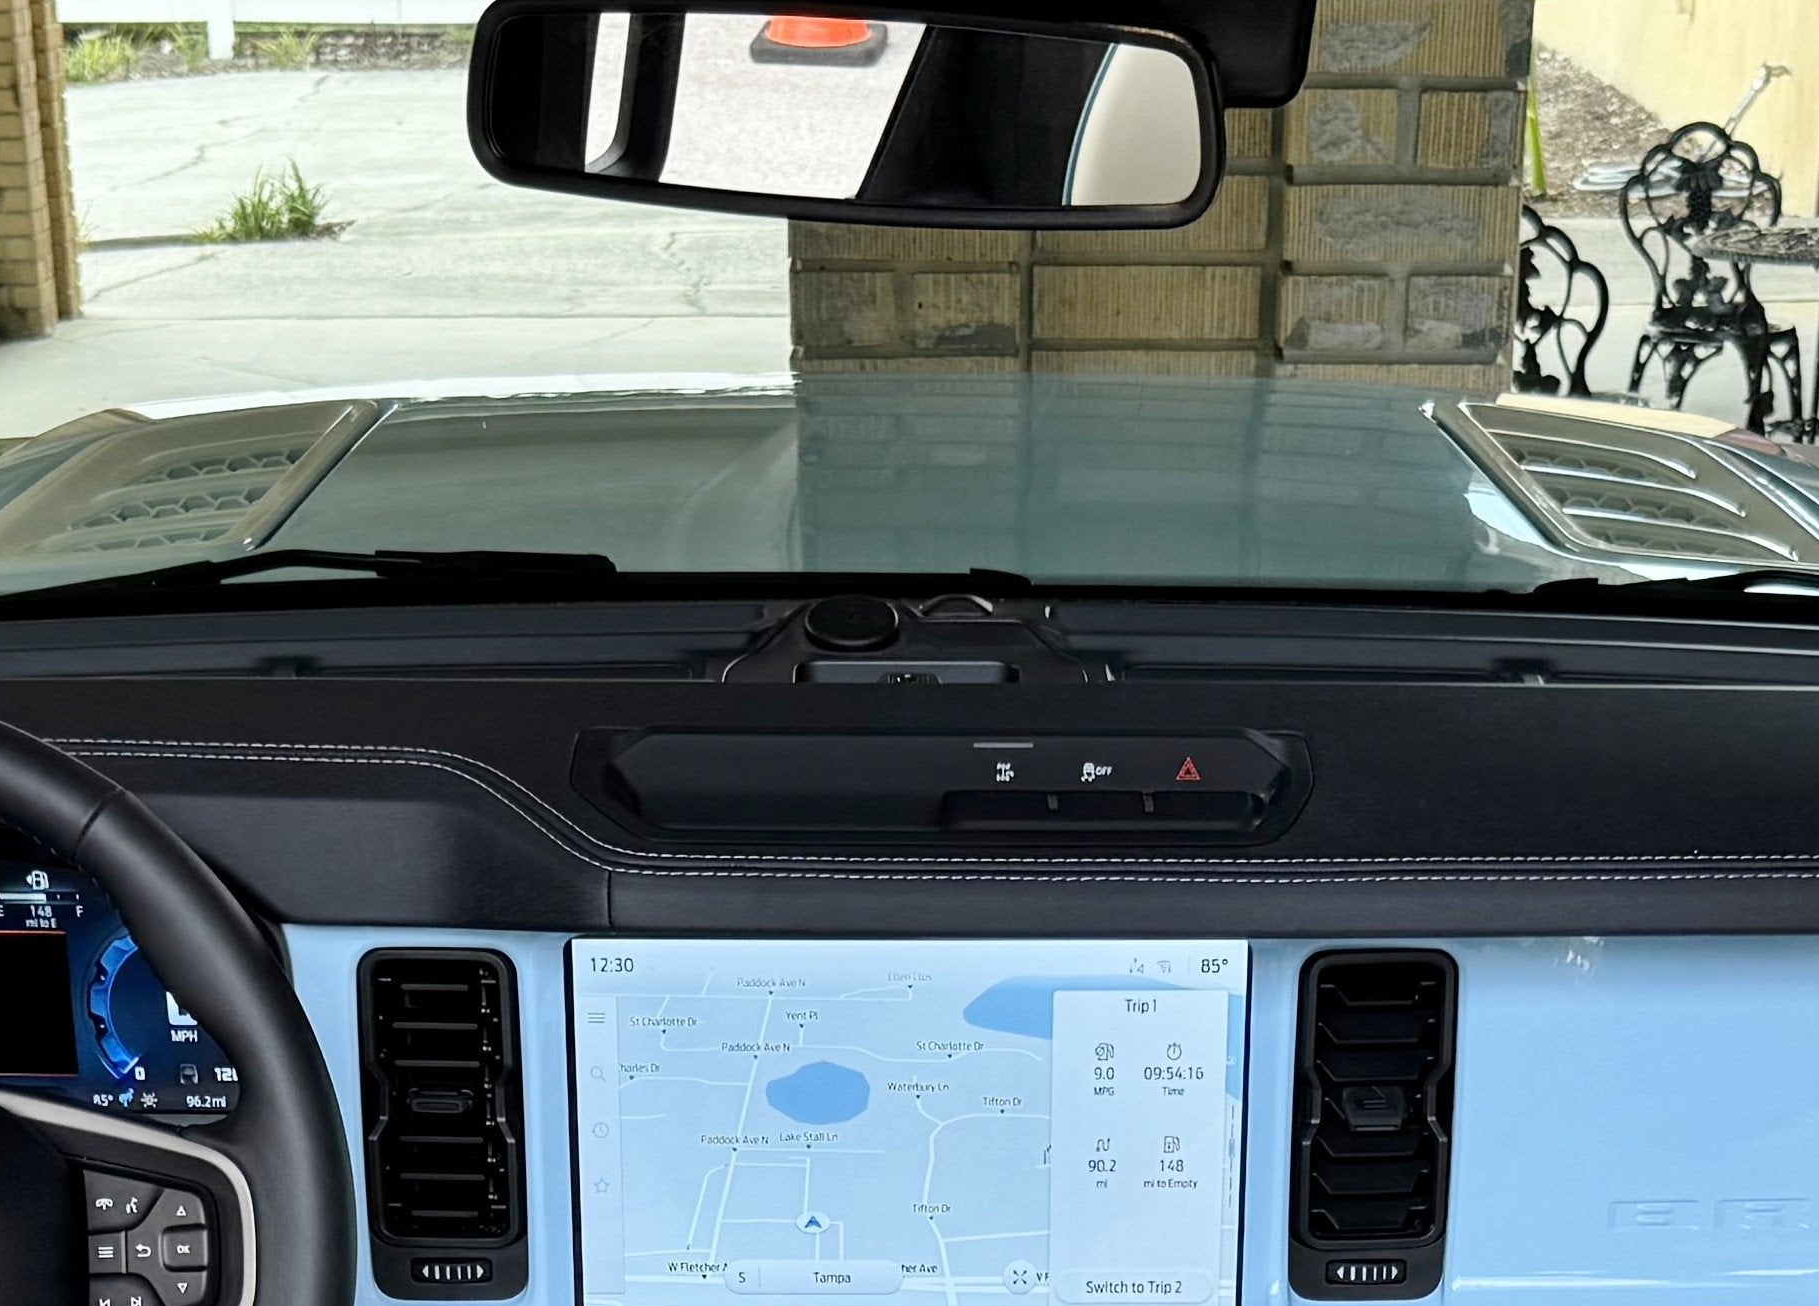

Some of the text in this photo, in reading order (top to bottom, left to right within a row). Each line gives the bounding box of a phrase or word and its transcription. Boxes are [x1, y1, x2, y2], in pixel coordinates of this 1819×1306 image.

[30, 905, 52, 918] 148
[590, 957, 634, 973] 12:30
[1201, 959, 1229, 974] 85°
[737, 977, 776, 988] Paddock
[1124, 999, 1149, 1014] Trip
[630, 1017, 639, 1027] St
[642, 1017, 686, 1027] Charlotte
[170, 1030, 198, 1043] MPH
[722, 1042, 761, 1052] Paddock
[764, 1042, 781, 1052] Ave
[916, 1041, 926, 1052] St
[928, 1041, 972, 1052] Charlotte
[134, 1066, 146, 1081] 0
[1094, 1067, 1115, 1081] 9.0
[1143, 1067, 1204, 1081] 09:54:16
[1162, 1086, 1185, 1097] Time
[701, 1134, 739, 1145] Paddock
[743, 1135, 759, 1145] Ave
[780, 1132, 802, 1142] Lake
[1088, 1159, 1117, 1173] 90.2
[1159, 1159, 1184, 1173] 148
[1156, 1179, 1166, 1188] to
[1168, 1179, 1198, 1190] Empty
[176, 1244, 191, 1254] OK
[680, 1261, 720, 1273] Fletcher
[738, 1272, 746, 1284] S
[813, 1271, 851, 1285] Tampa
[1086, 1281, 1182, 1295] Switch to Trip 2
